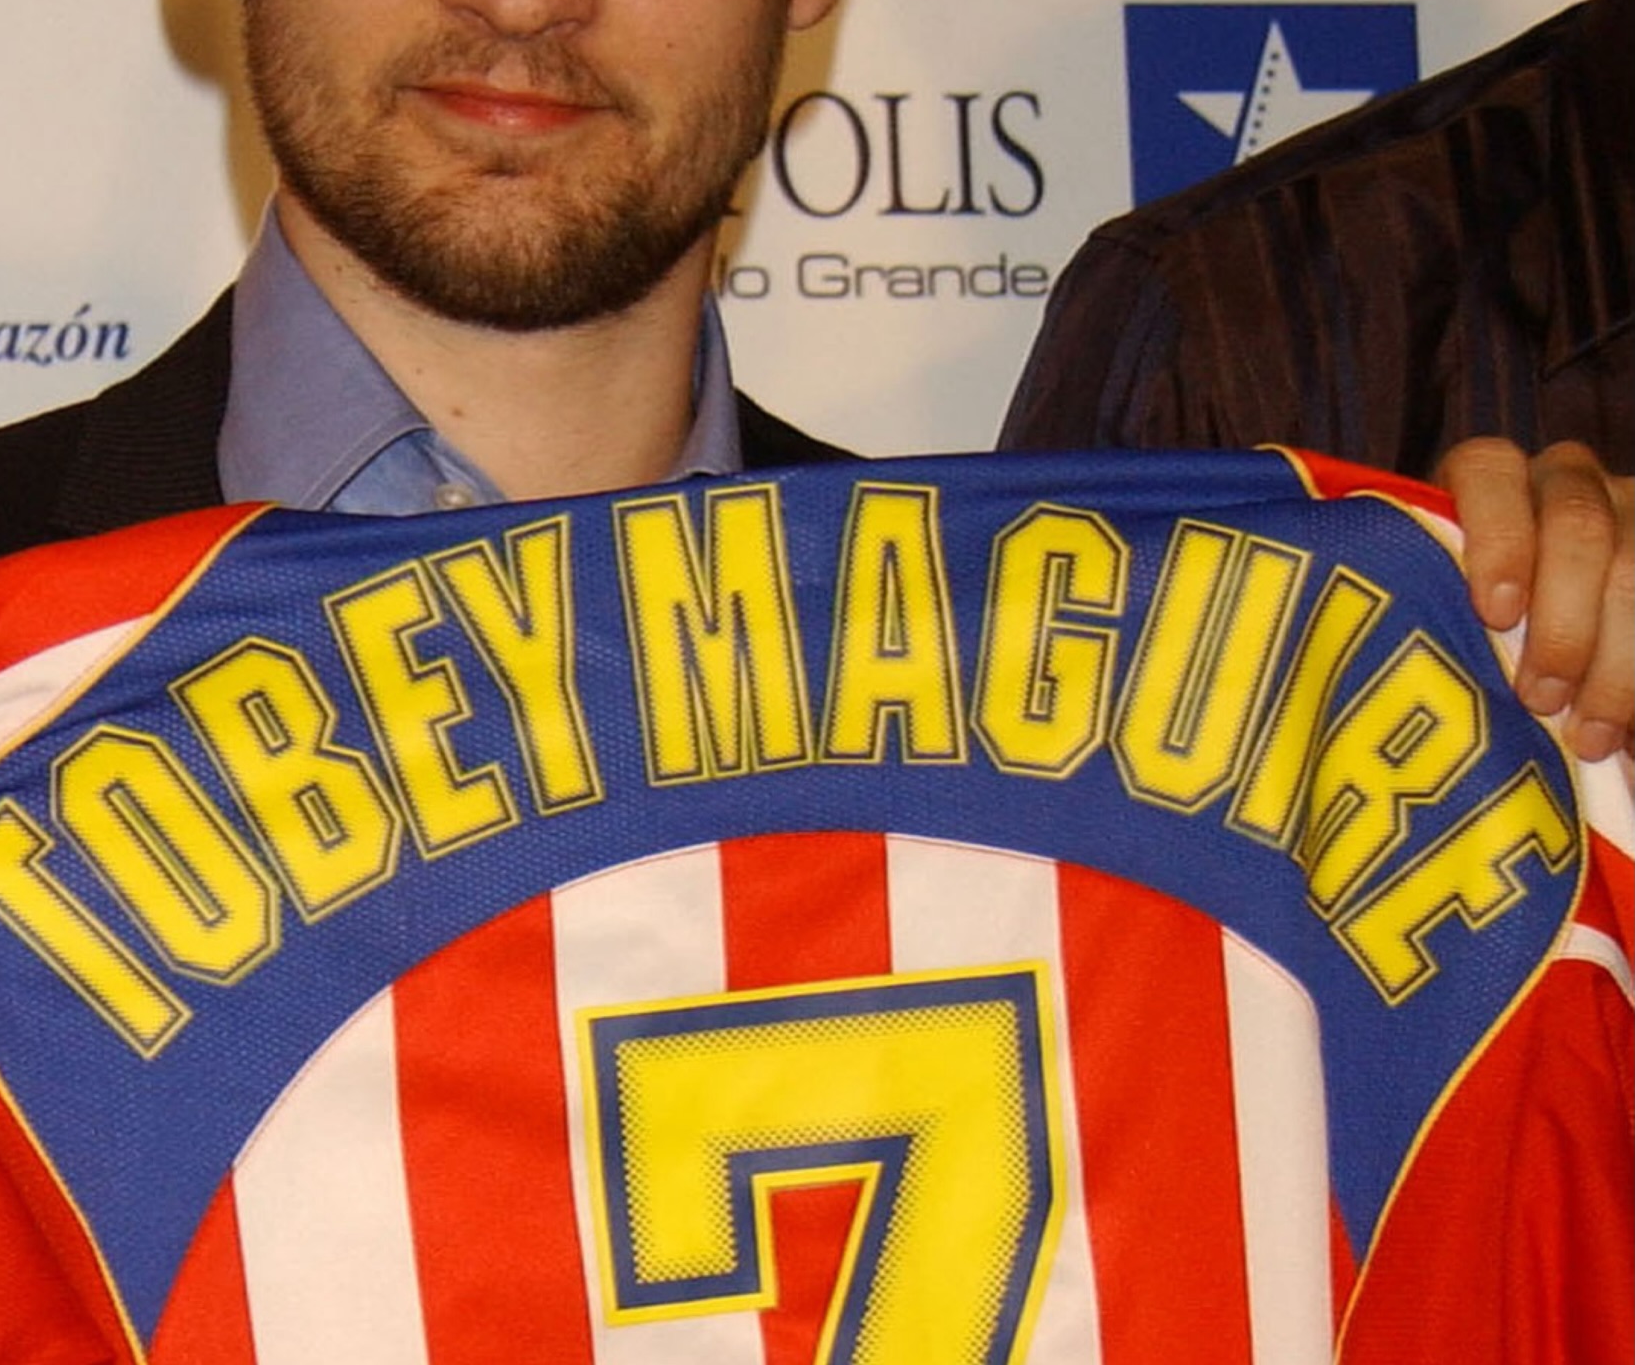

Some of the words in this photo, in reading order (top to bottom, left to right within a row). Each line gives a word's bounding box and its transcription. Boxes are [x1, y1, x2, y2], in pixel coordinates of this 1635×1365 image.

[771, 90, 1045, 219] OLIS
[796, 253, 1050, 299] Grande
[611, 478, 1580, 1011] MAGUIRE
[574, 959, 1070, 1365] 7
